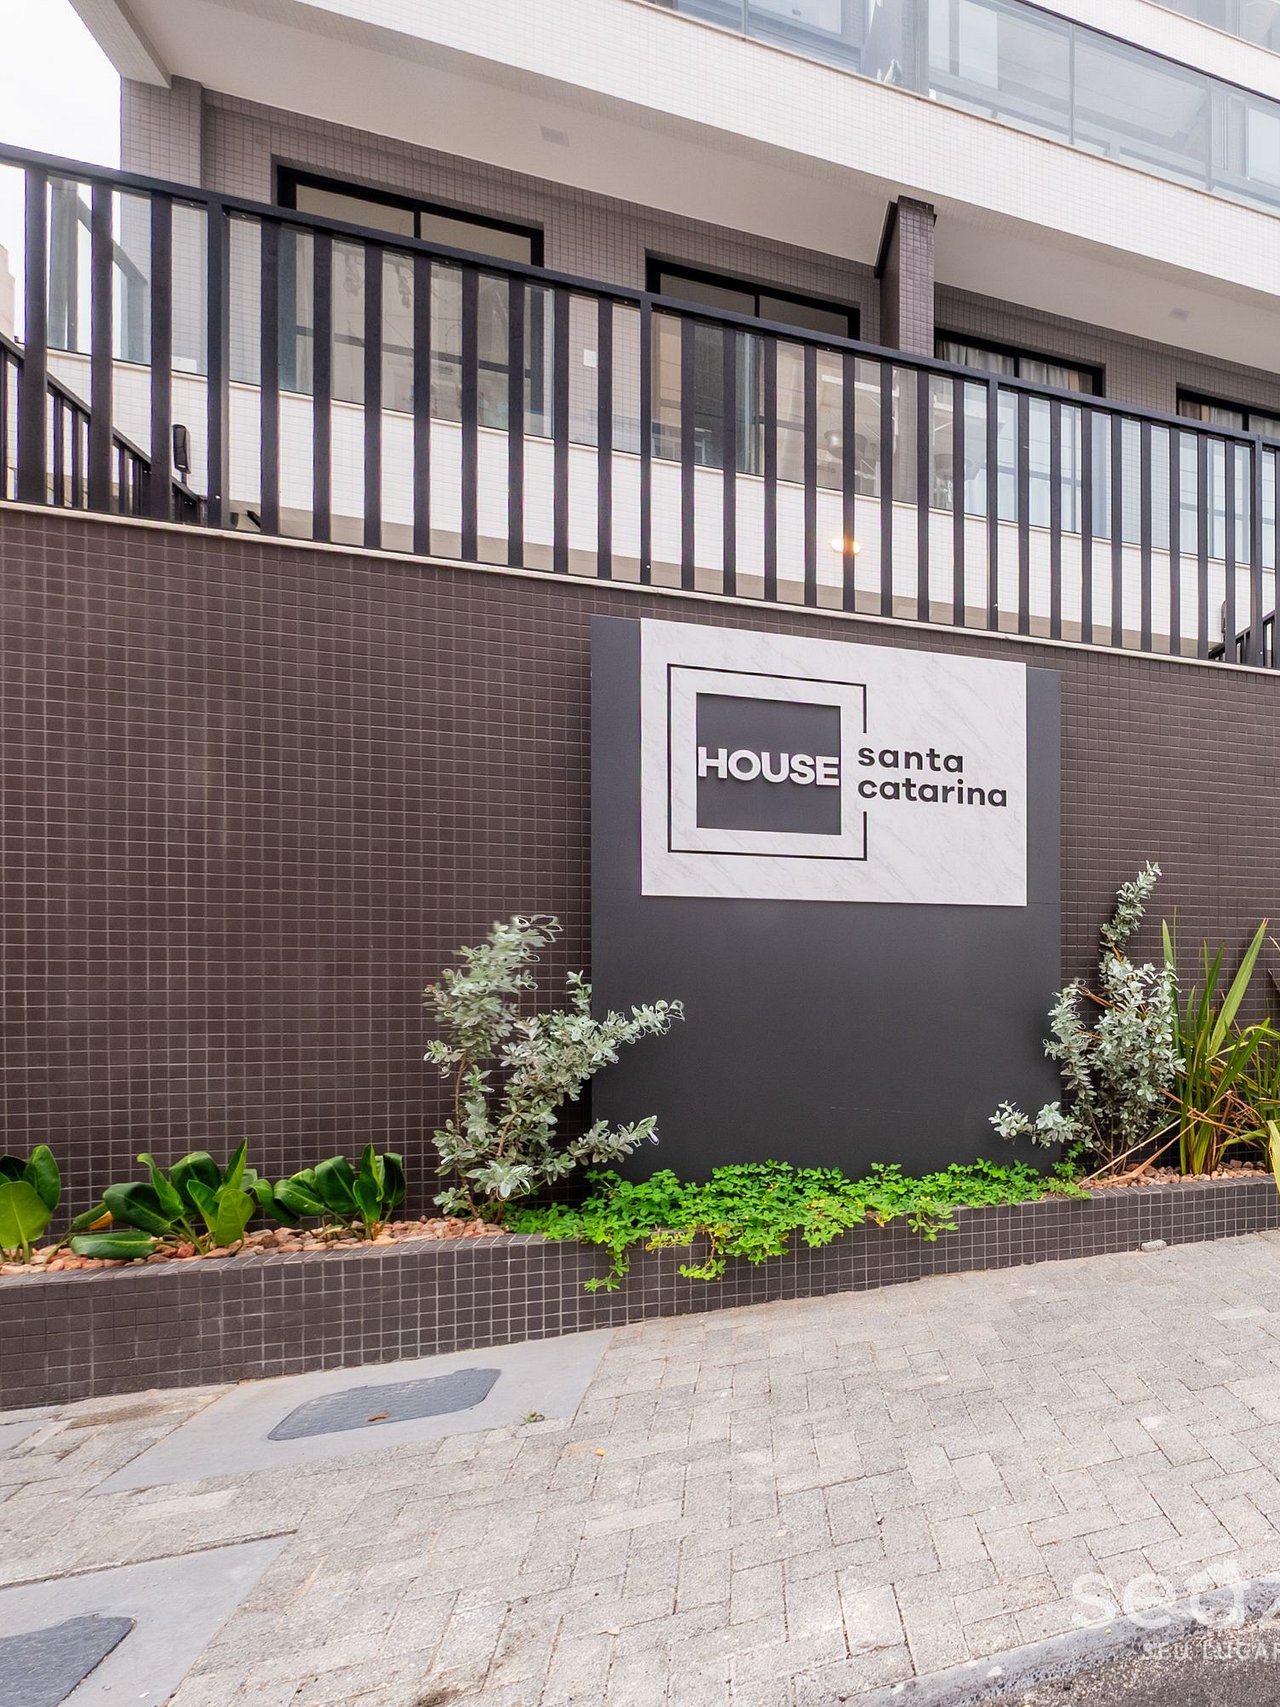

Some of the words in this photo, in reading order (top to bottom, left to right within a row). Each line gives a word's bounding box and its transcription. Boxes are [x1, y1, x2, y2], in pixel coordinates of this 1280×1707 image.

[697, 746, 840, 786] HOUSE
[857, 746, 964, 773] santa
[857, 778, 1007, 807] catarina
